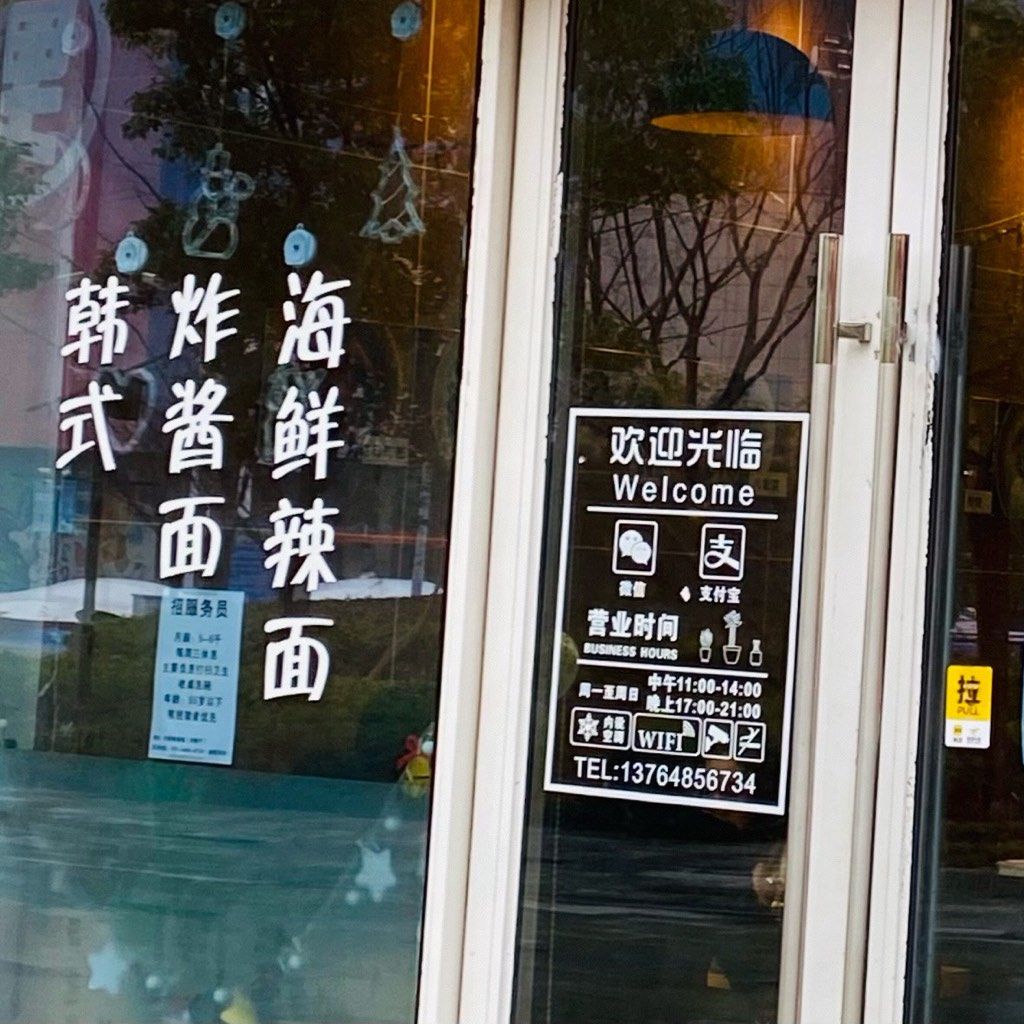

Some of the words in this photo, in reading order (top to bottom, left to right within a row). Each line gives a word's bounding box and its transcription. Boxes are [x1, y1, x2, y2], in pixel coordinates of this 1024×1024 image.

[55, 275, 132, 472] 韩式
[158, 272, 241, 580] 炸酱面
[609, 426, 763, 471] 欢迎光临
[262, 270, 352, 702] 海鲜辣面
[613, 473, 755, 506] Welcome
[698, 584, 741, 604] 支付宝
[587, 609, 680, 642] 营业时间
[583, 641, 637, 658] BUSINESS
[639, 646, 679, 661] HOURS
[647, 672, 763, 698] 中午11:00-14:00
[957, 675, 981, 706] 拉
[957, 706, 979, 716] PULL
[637, 729, 683, 752] WIFI
[573, 755, 757, 795] TEL:13764856734
